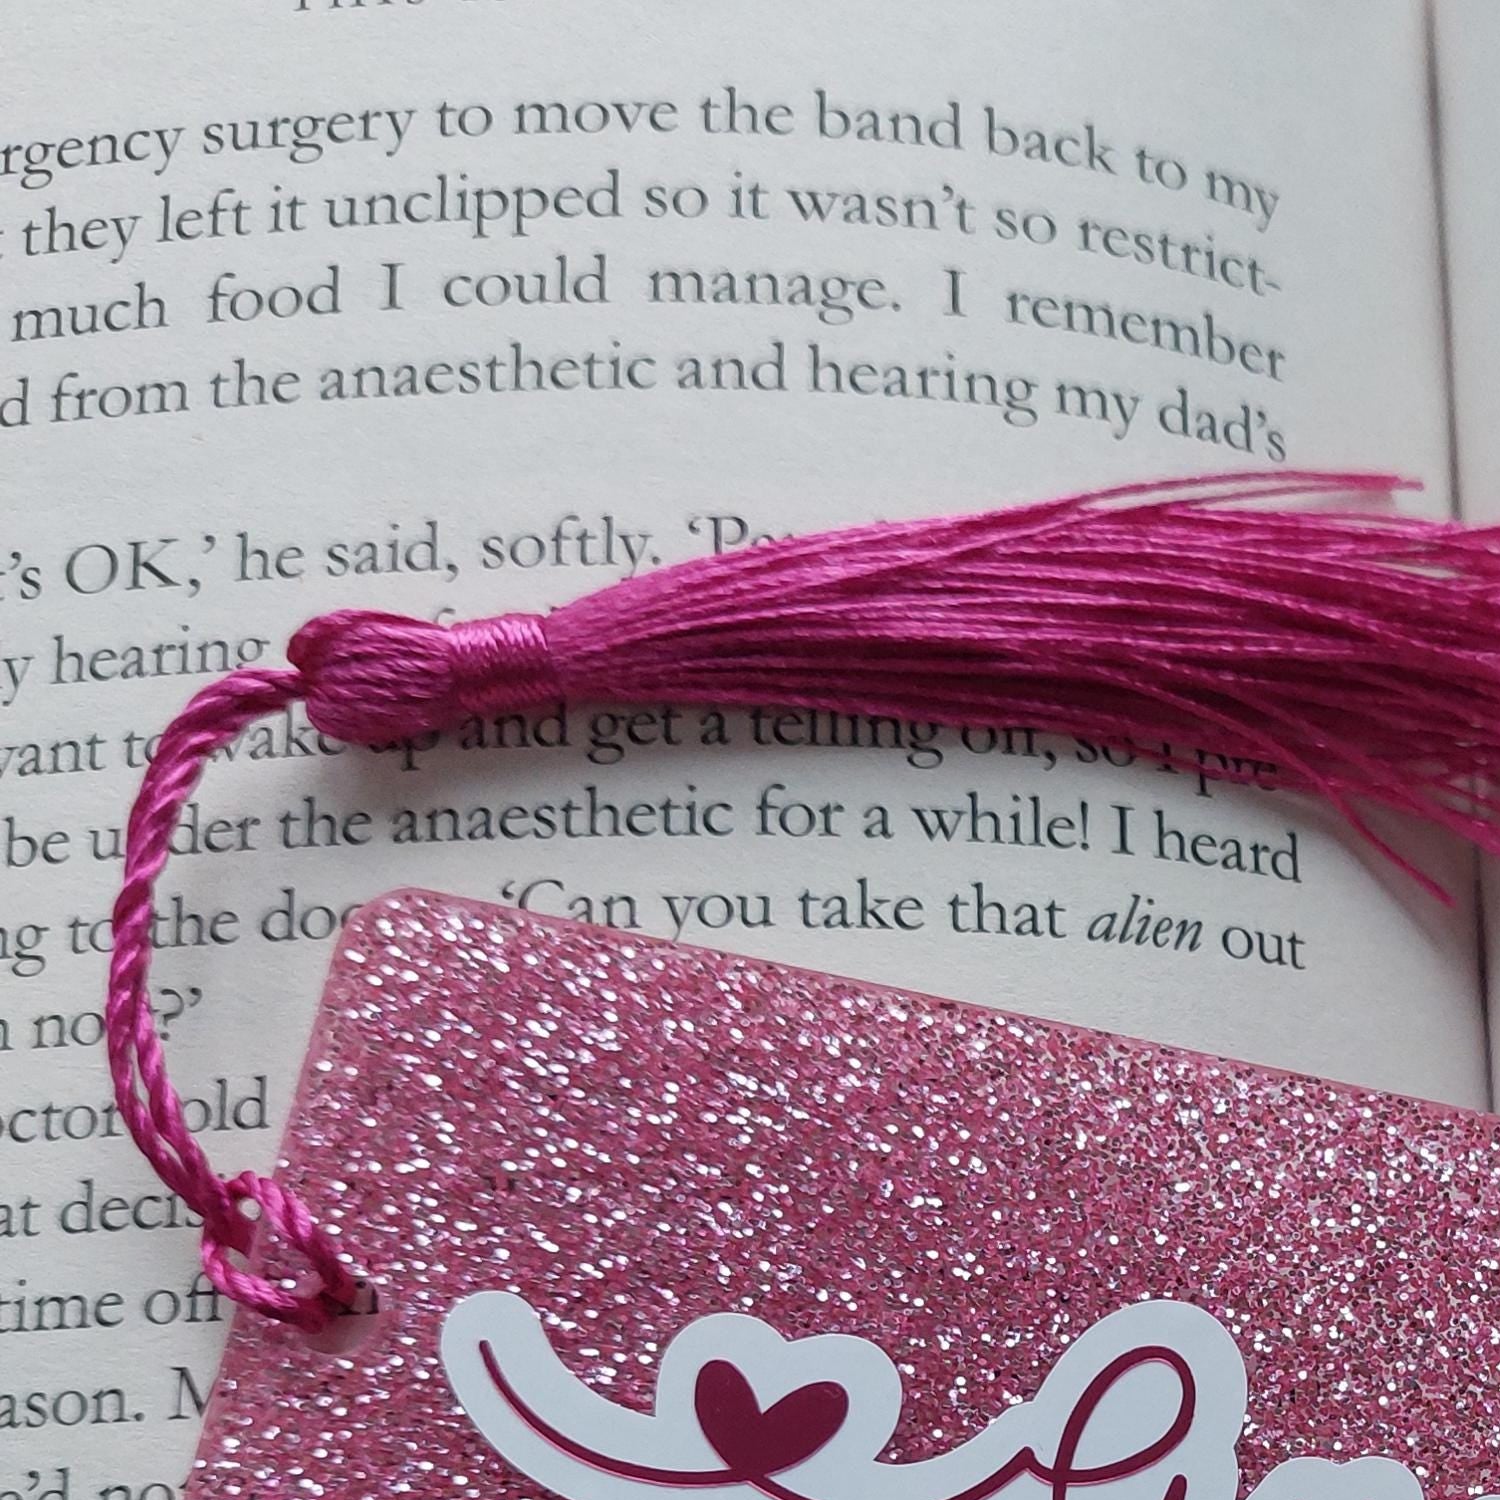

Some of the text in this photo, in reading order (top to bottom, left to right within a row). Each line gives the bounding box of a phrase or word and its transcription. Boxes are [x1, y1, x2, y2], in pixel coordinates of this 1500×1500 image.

[202, 85, 1280, 233] surgery to move the band back to my
[10, 252, 1286, 382] much food I could manage. I remember
[275, 783, 1303, 884] the anaesthetic for a while! I heard
[661, 876, 1307, 971] you take that alien out
